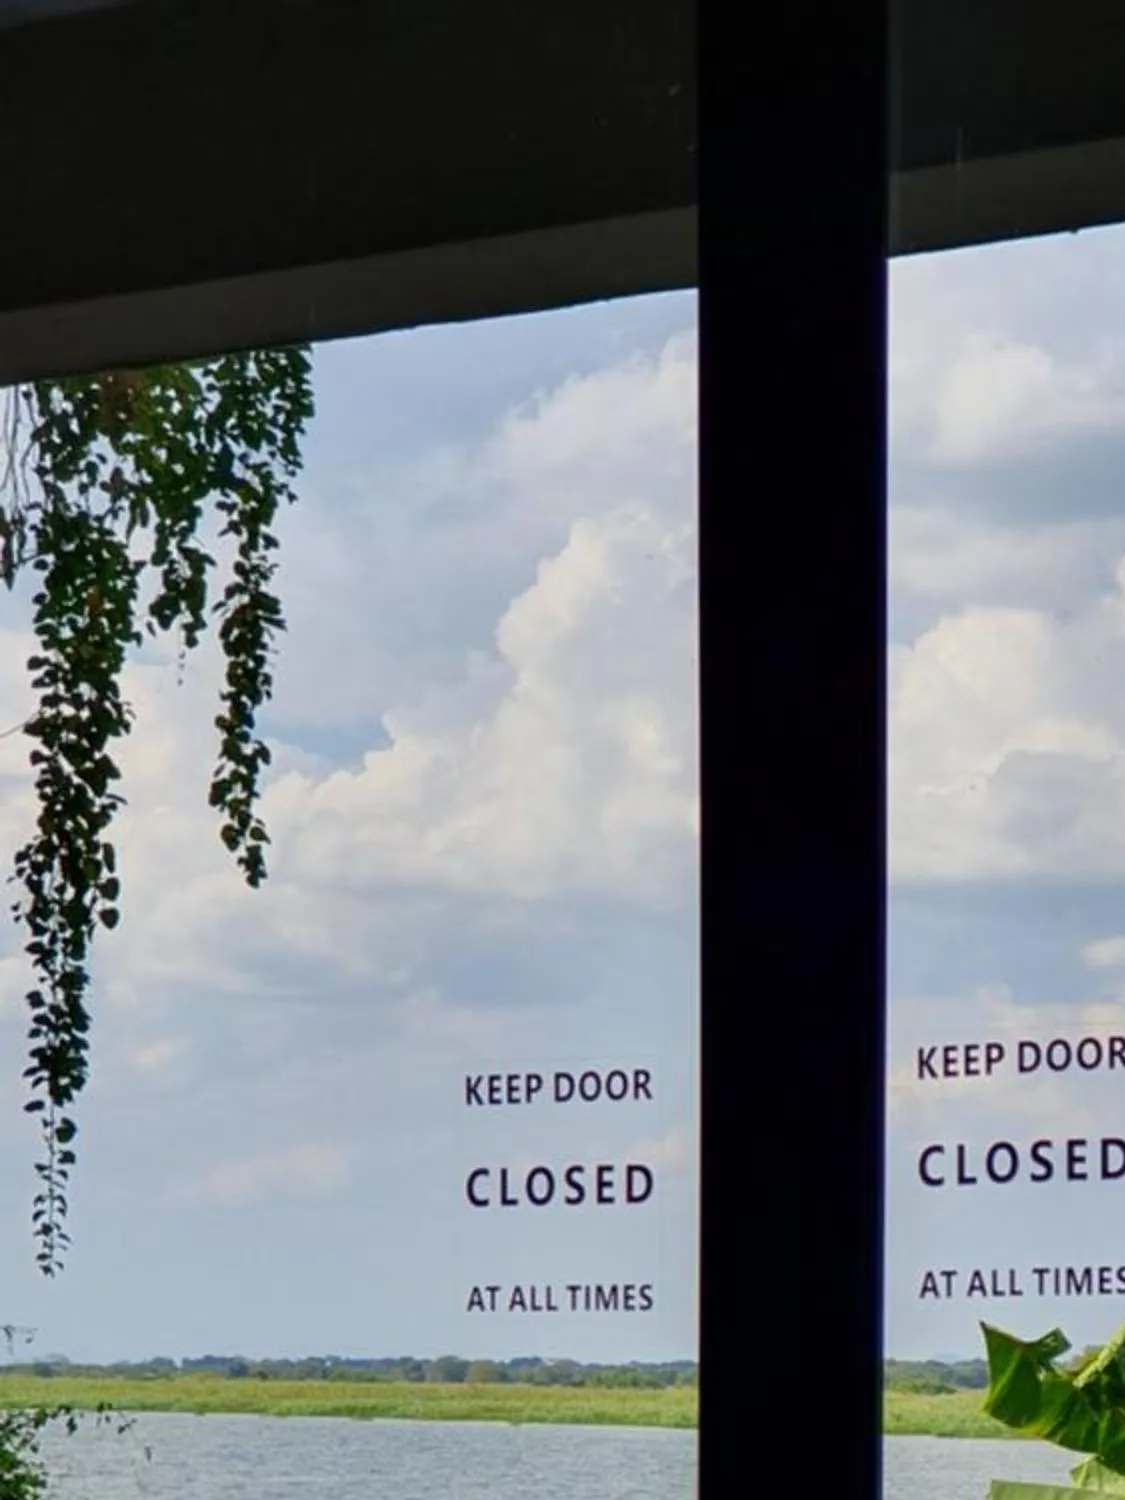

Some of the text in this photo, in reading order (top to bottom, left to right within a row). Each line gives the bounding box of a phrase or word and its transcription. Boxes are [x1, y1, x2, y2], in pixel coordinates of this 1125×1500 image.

[917, 1042, 1005, 1080] KEEP
[465, 1069, 653, 1106] KEEP DOOR
[466, 1164, 654, 1208] CLOSED
[467, 1283, 653, 1312] AT ALL TIMES
[919, 1270, 958, 1299] AT
[967, 1269, 1023, 1297] ALL
